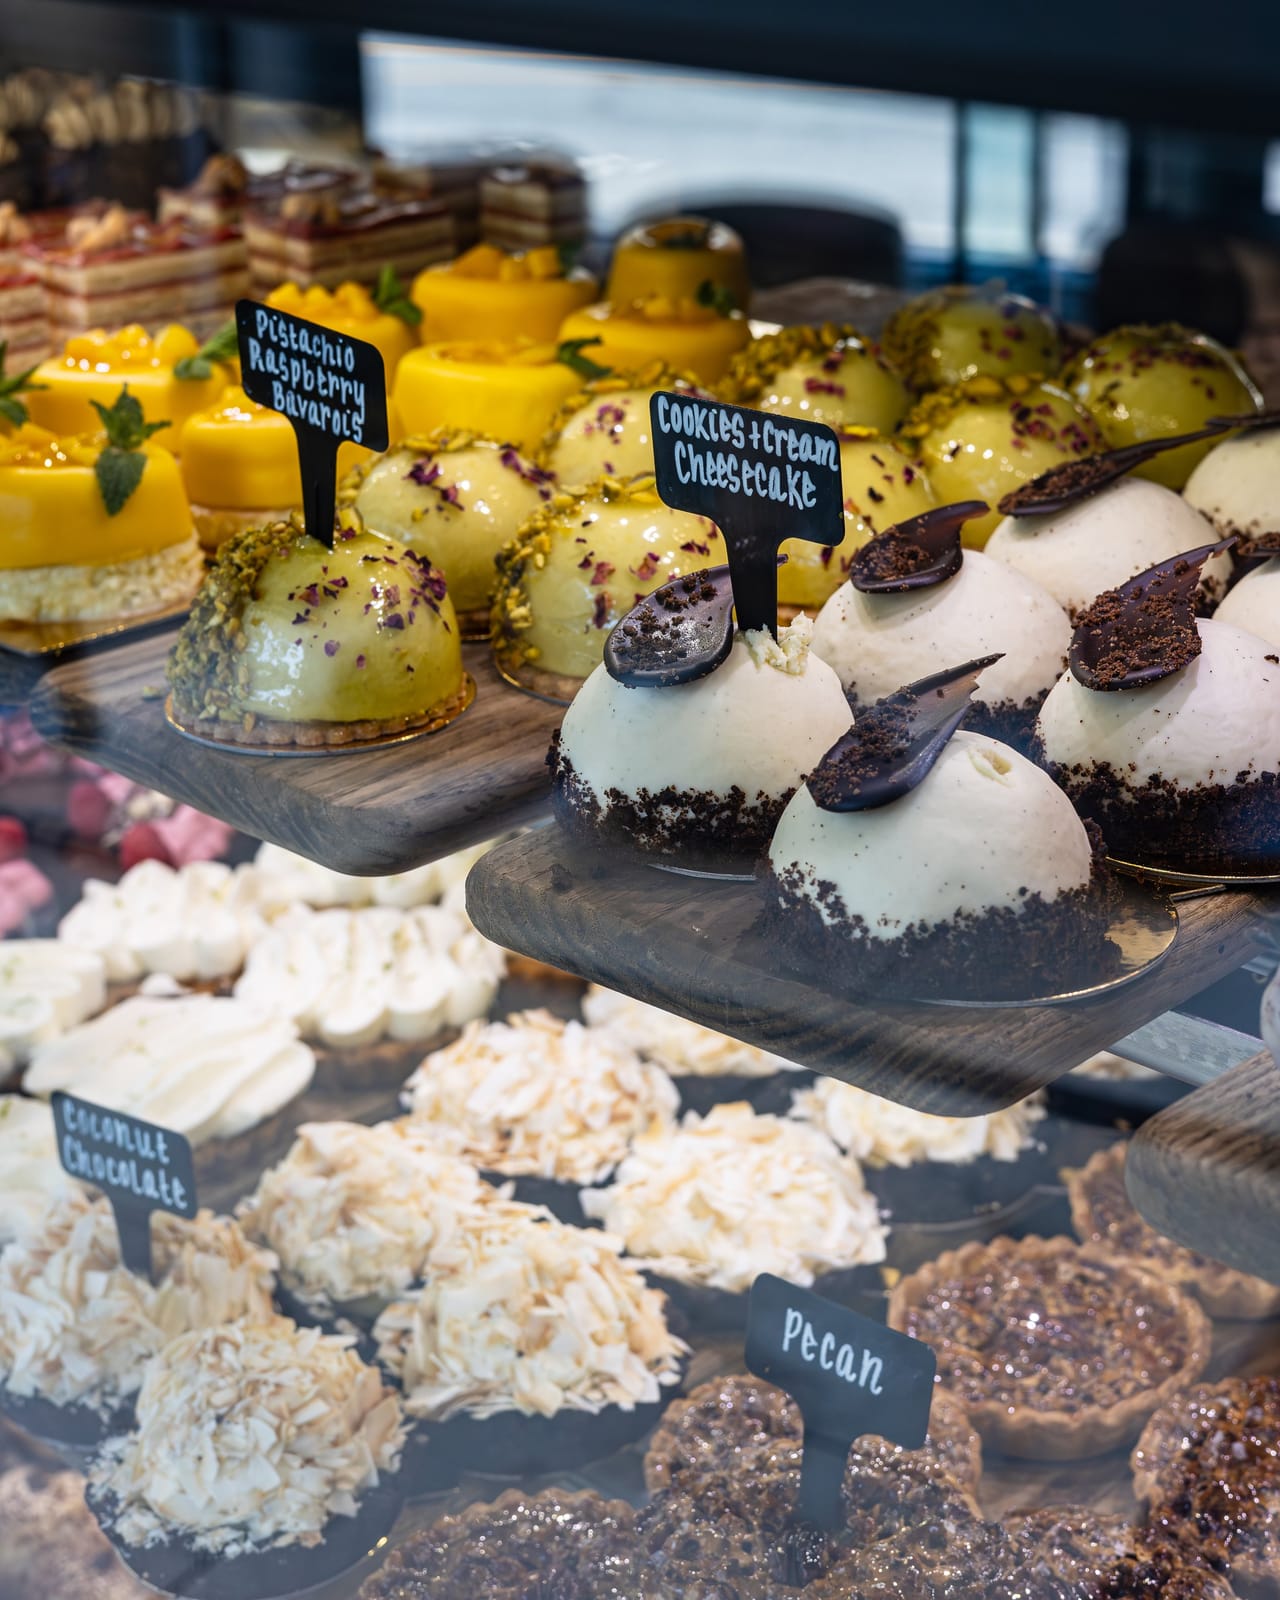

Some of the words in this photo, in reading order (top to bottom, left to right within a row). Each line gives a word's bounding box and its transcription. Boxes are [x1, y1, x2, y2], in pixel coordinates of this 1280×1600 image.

[255, 309, 355, 372] Pistachio
[248, 337, 365, 425] Raspberry
[272, 380, 362, 443] Bavarois
[674, 440, 817, 510] Cheesecake
[63, 1099, 170, 1165] Coconut
[63, 1135, 188, 1209] Chocolate
[782, 1307, 883, 1395] Pecan
